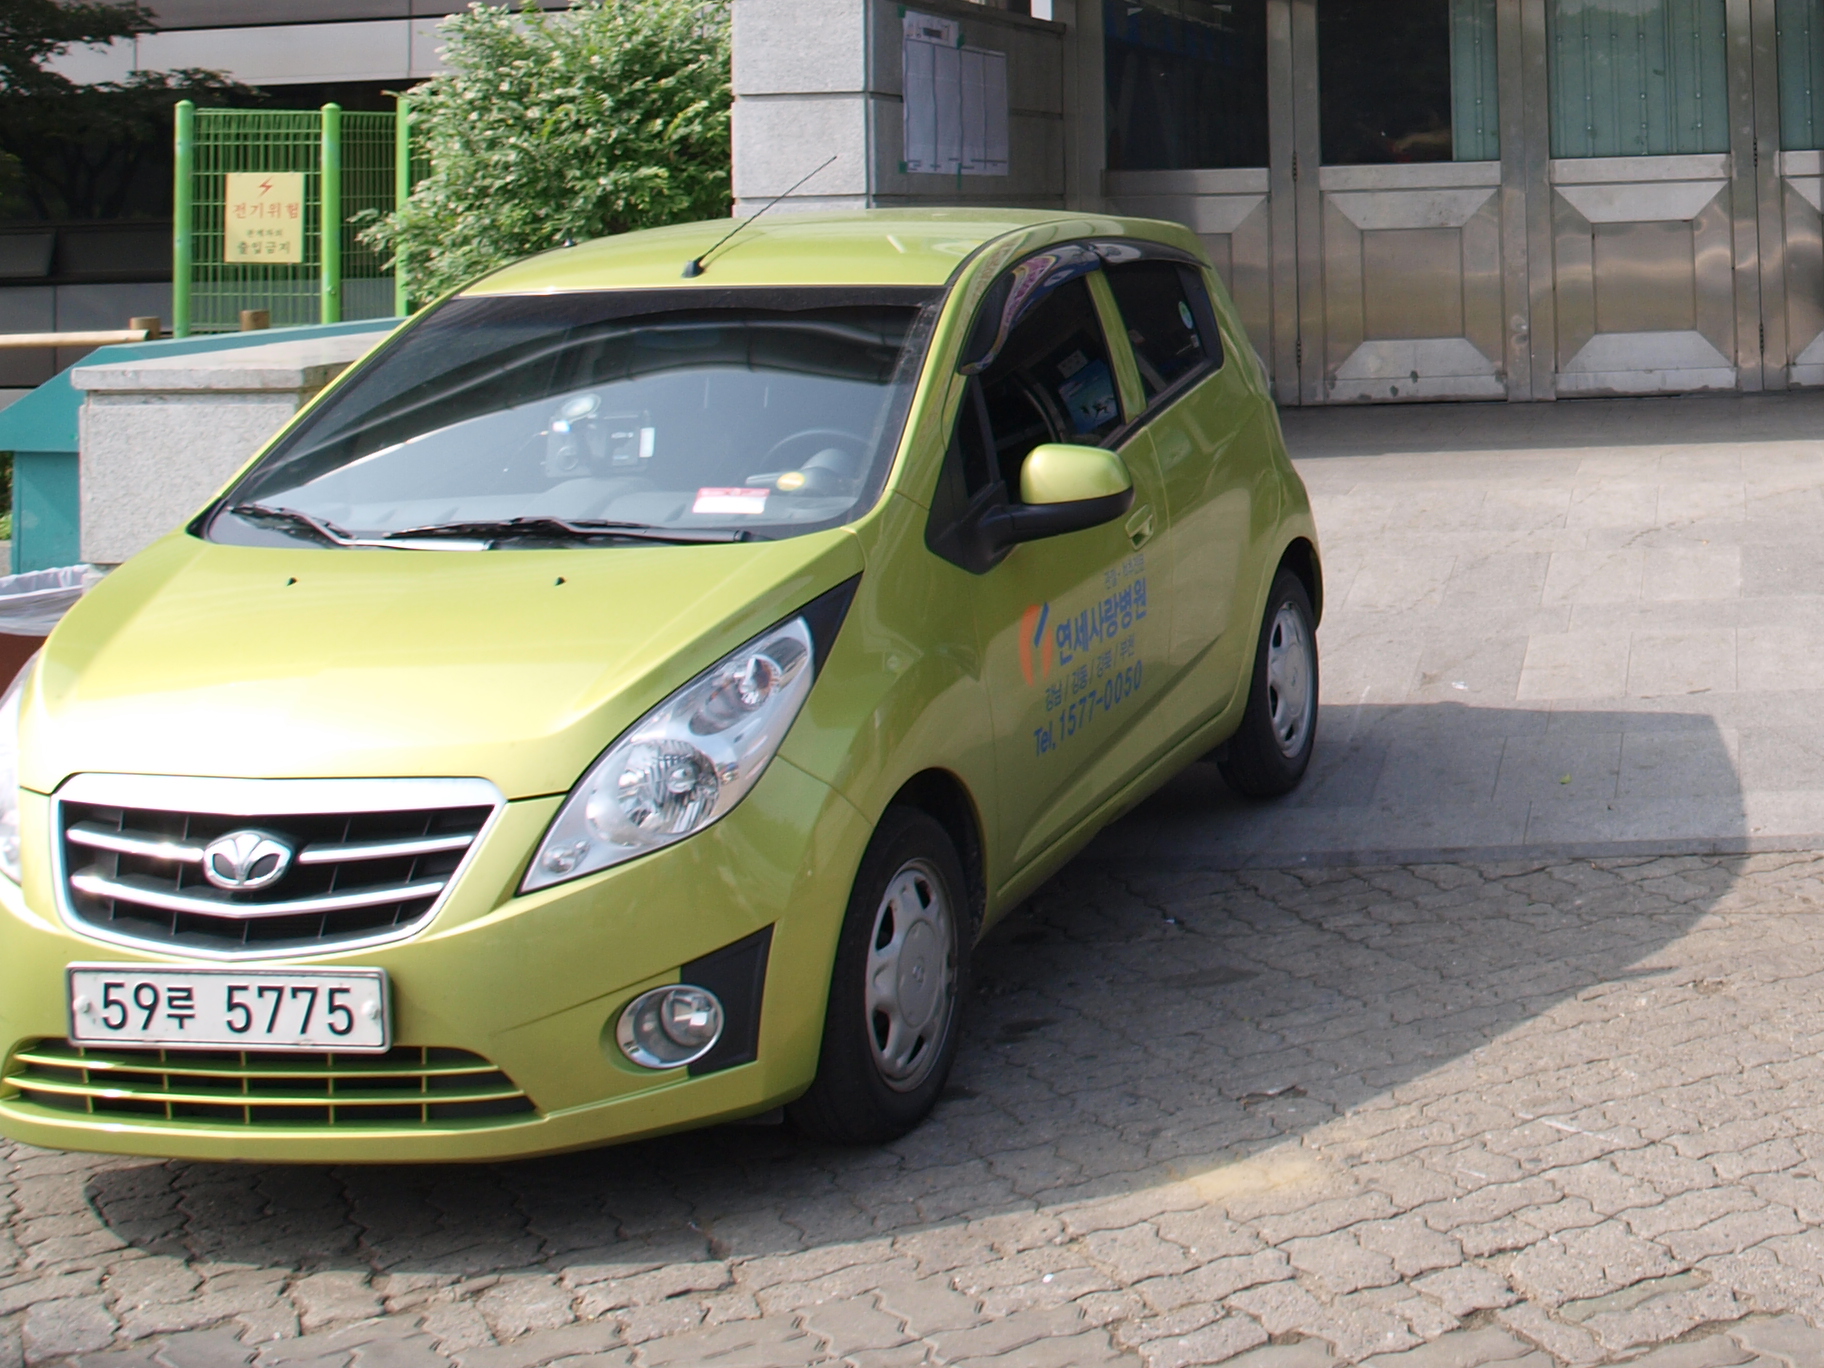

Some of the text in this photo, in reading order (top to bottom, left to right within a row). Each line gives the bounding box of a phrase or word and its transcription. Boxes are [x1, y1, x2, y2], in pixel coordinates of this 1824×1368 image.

[1056, 577, 1148, 666] 연세사랑병원
[1059, 659, 1143, 743] 1577-0050
[100, 981, 354, 1036] 59루 5775
